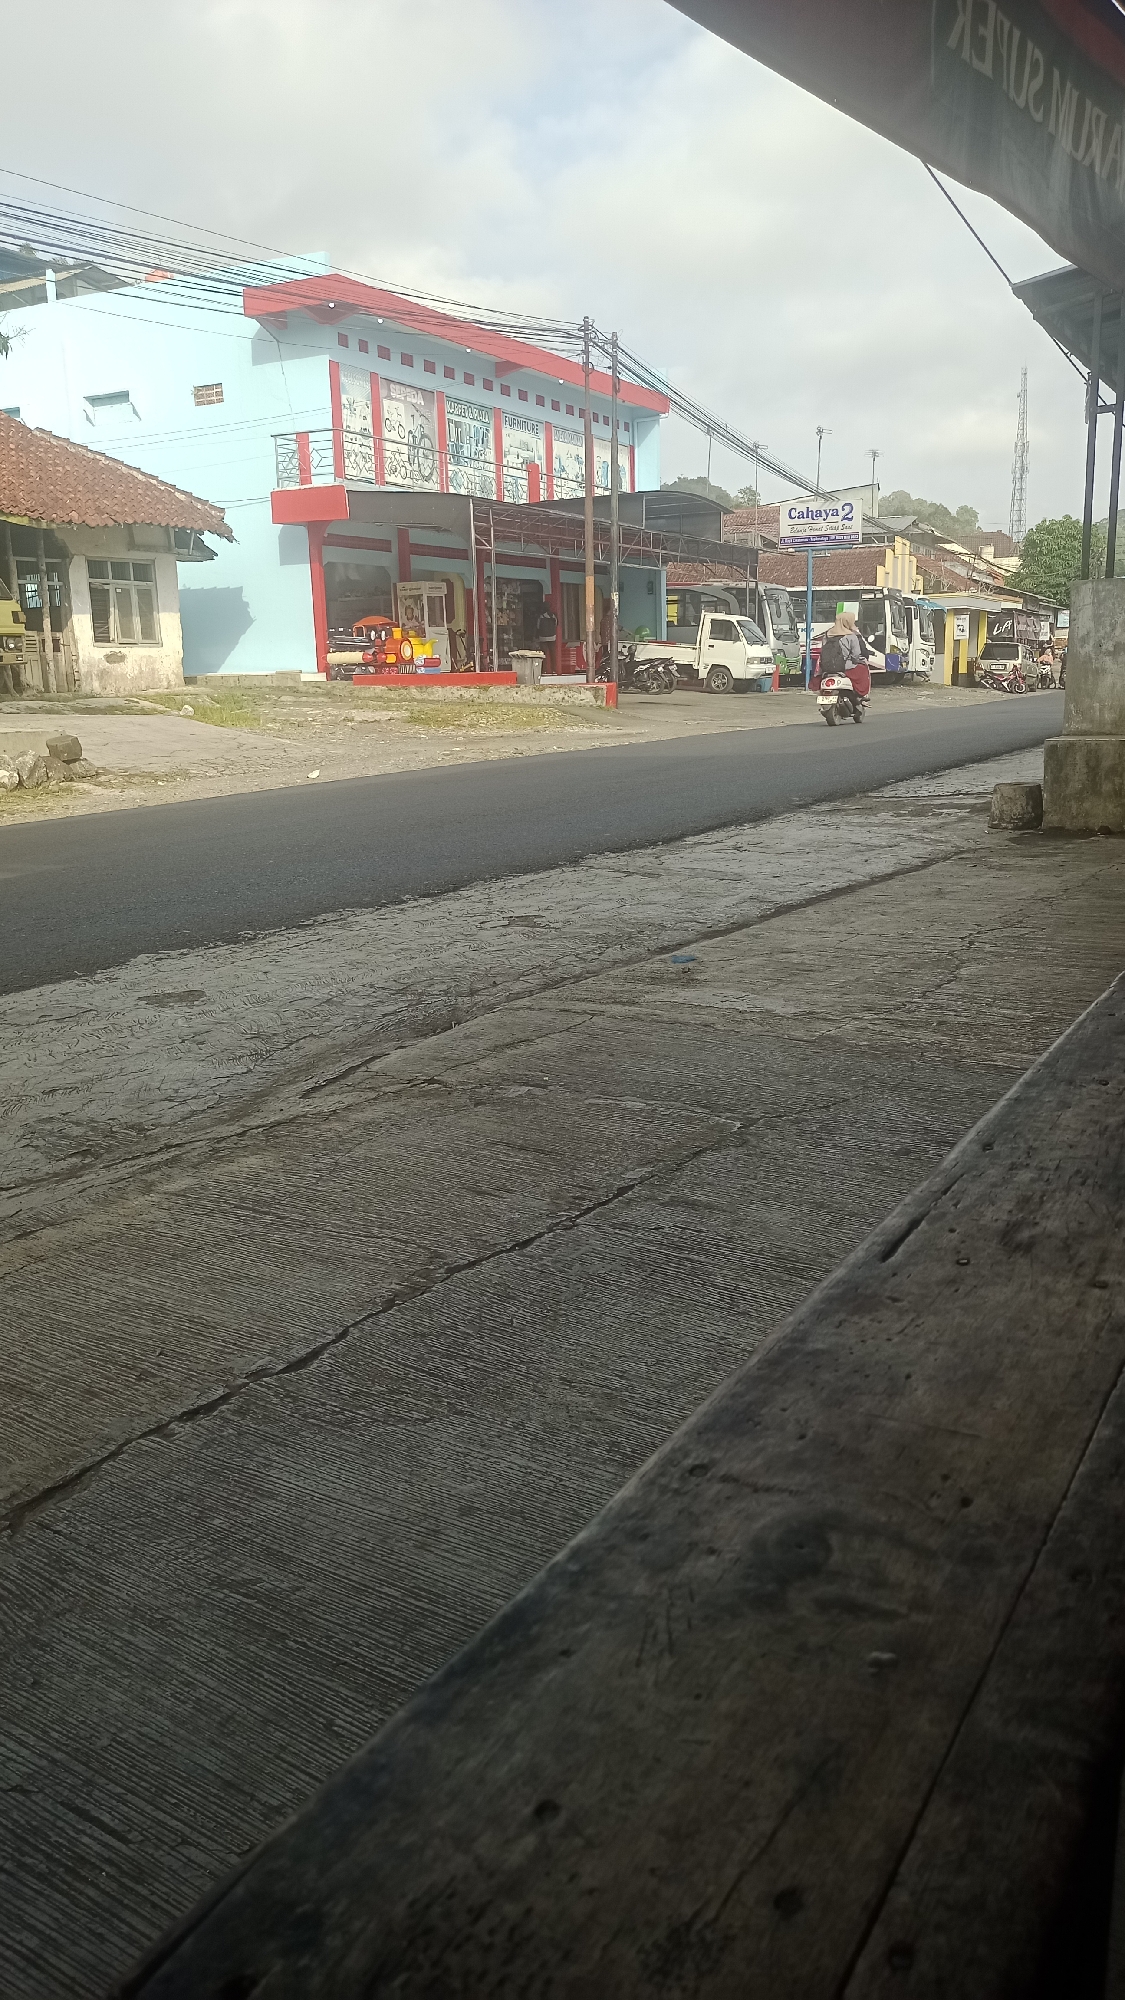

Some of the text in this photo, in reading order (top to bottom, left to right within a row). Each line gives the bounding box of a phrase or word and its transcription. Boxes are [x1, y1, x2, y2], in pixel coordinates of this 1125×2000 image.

[389, 383, 425, 406] SEPEDA
[504, 415, 540, 435] FURNITURE
[788, 503, 853, 521] Cahaya 2
